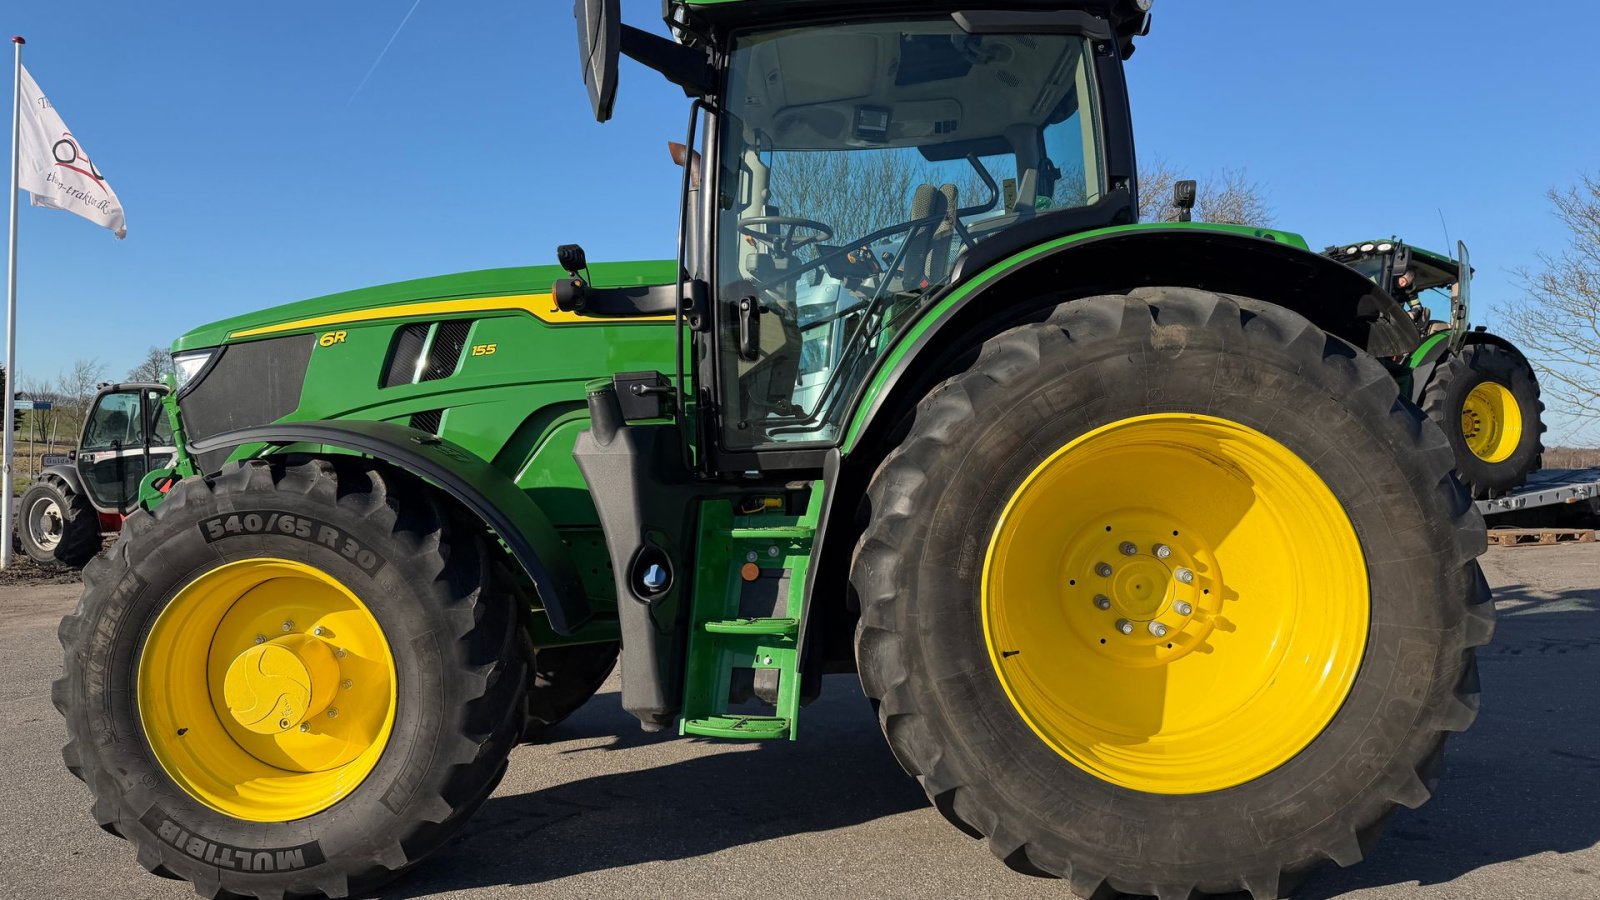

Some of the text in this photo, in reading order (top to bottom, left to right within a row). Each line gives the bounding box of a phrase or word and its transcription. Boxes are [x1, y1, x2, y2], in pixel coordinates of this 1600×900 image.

[319, 329, 348, 348] 6R
[471, 343, 497, 356] 155
[206, 513, 376, 569] 540/65 R 30
[157, 819, 306, 871] MULTIBIB
